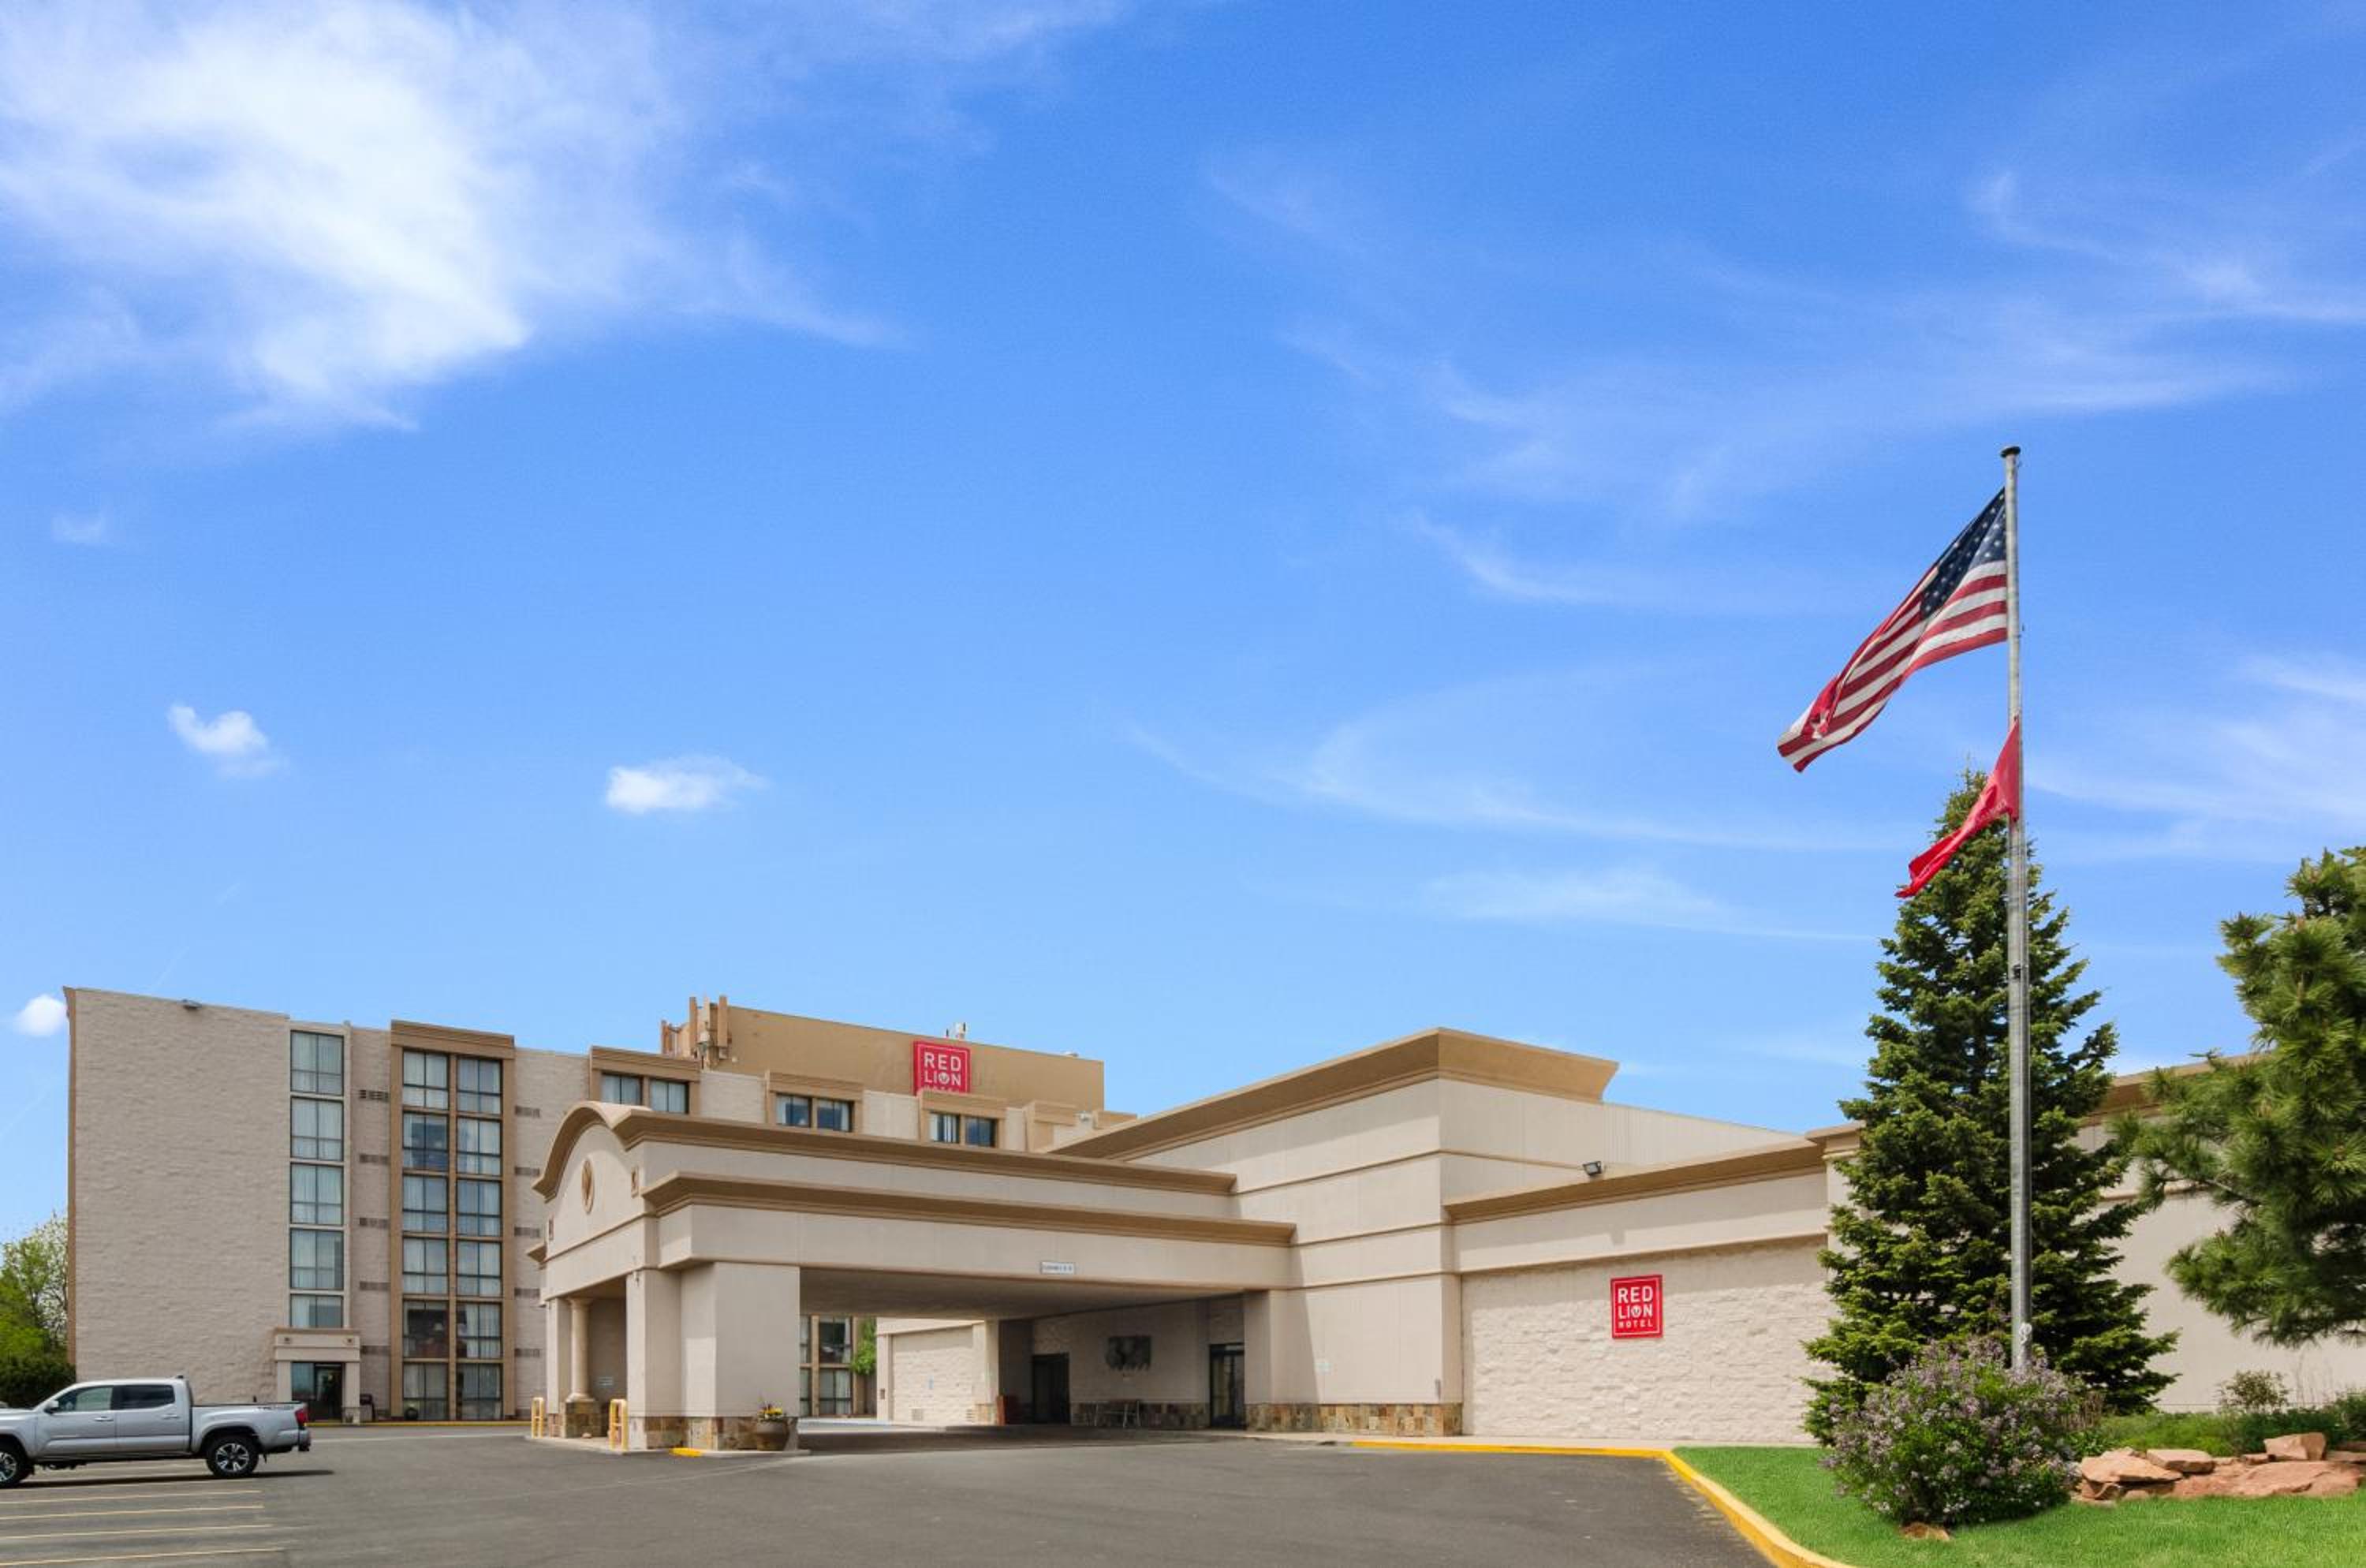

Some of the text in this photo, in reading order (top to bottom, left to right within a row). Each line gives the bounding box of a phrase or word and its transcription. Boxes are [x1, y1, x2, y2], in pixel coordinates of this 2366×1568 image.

[924, 1051, 961, 1071] RED
[924, 1070, 961, 1086] LION
[1618, 1286, 1653, 1304] RED
[1618, 1304, 1653, 1320] LION
[1618, 1319, 1653, 1329] HOTEL
